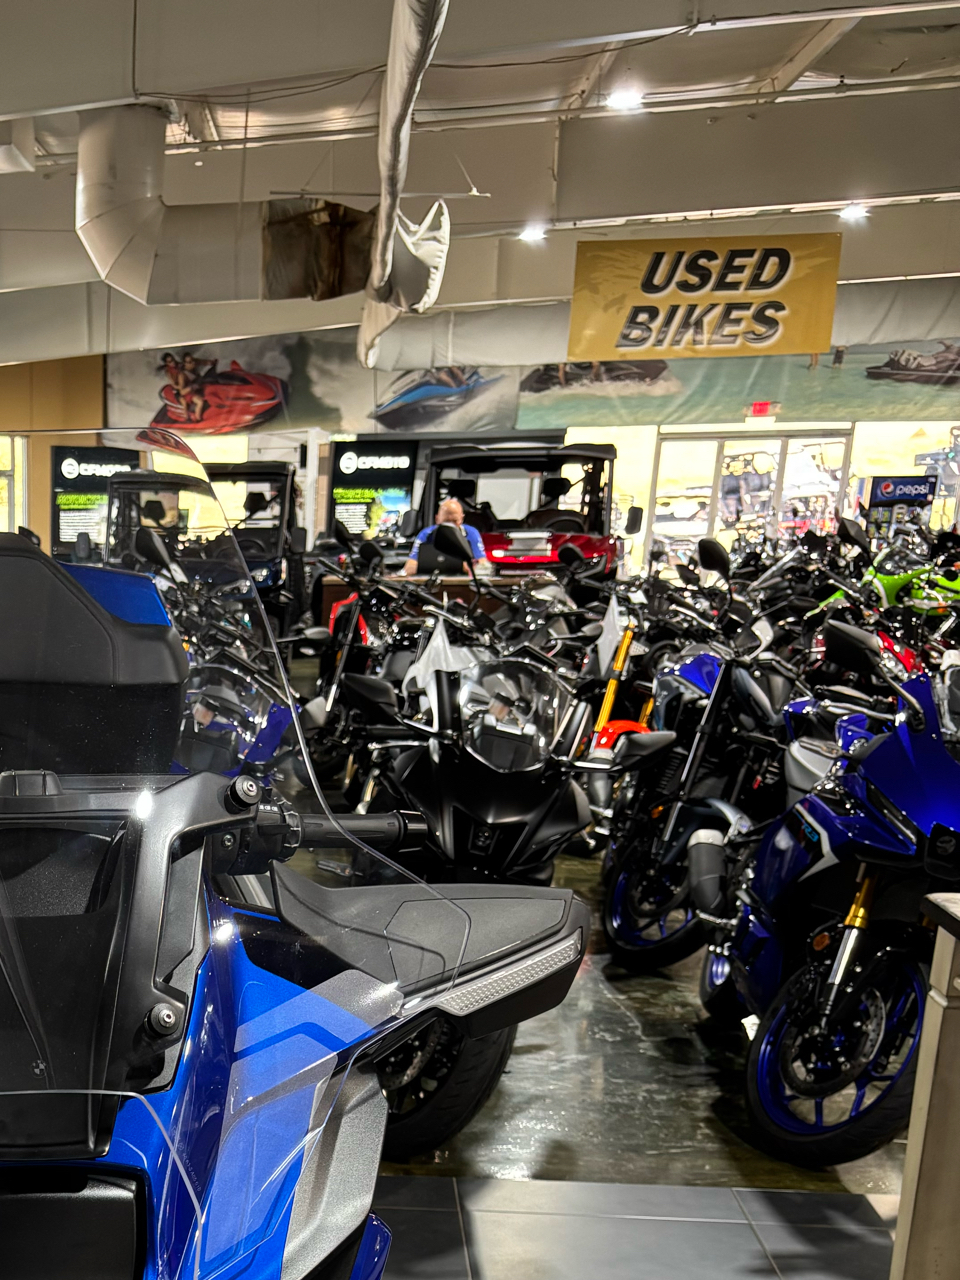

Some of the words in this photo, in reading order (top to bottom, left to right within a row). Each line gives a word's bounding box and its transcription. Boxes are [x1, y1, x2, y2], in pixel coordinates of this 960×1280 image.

[640, 248, 791, 294] USED
[615, 300, 787, 348] BIKES
[895, 483, 930, 497] pepsi
